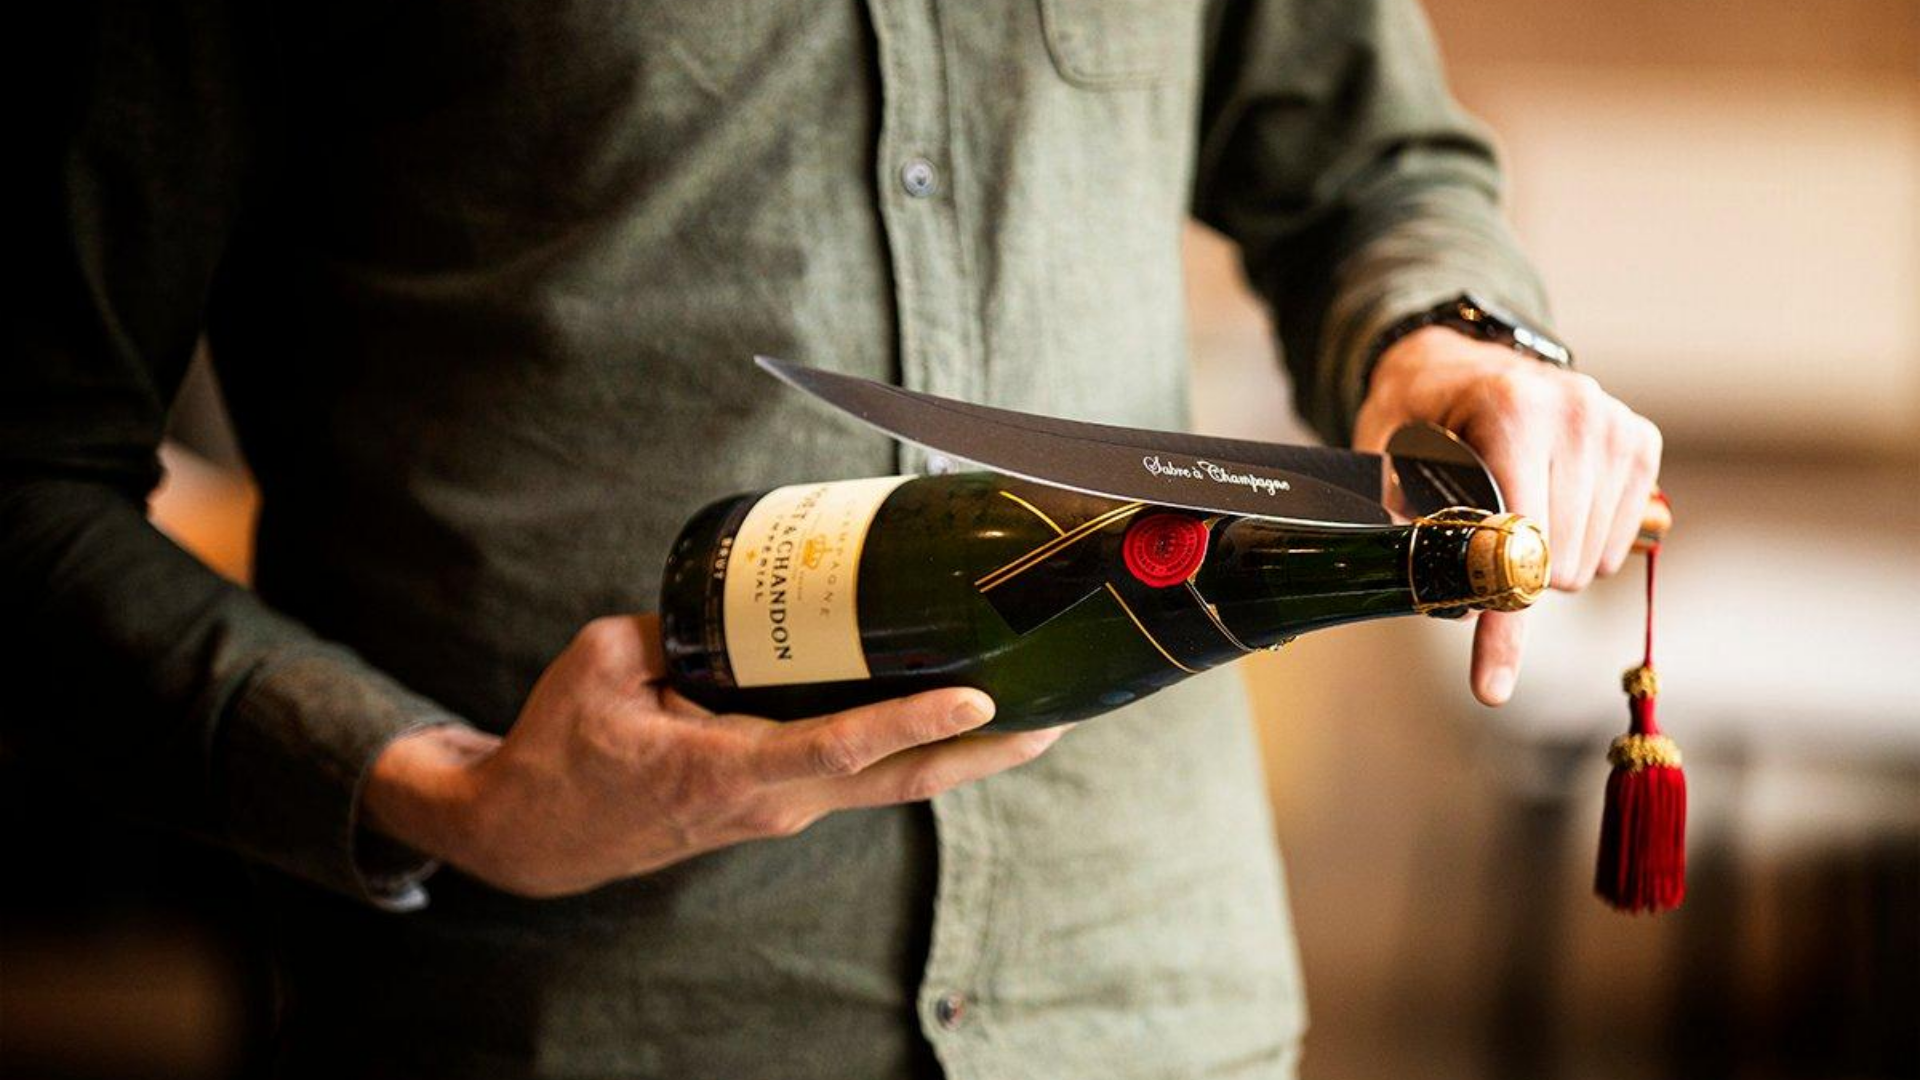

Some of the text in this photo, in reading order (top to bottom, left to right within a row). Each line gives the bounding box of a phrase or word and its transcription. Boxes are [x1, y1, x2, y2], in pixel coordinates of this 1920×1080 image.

[1143, 456, 1291, 496] Sabre à Champagne
[769, 540, 794, 660] CHANDON
